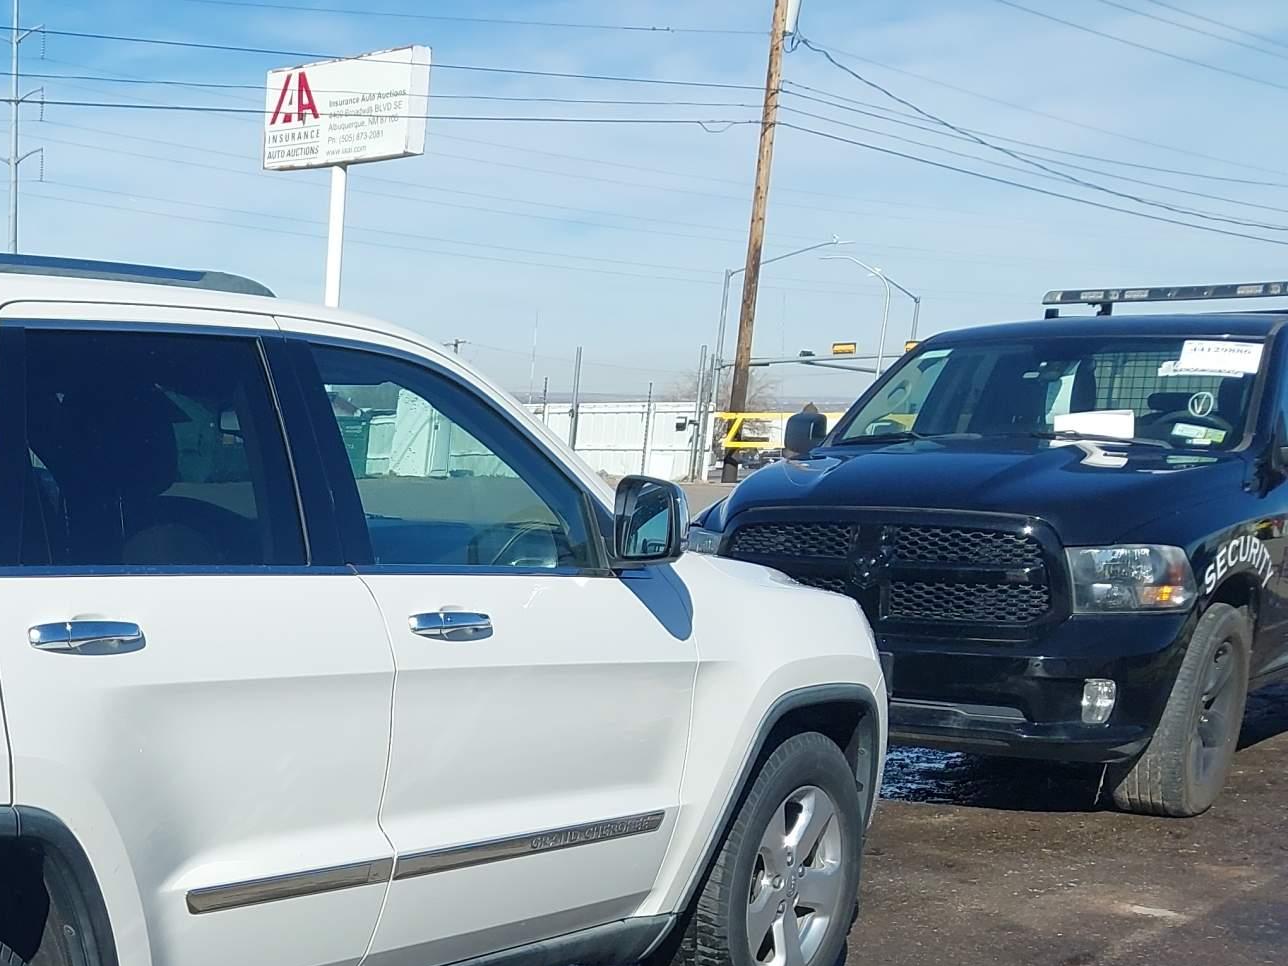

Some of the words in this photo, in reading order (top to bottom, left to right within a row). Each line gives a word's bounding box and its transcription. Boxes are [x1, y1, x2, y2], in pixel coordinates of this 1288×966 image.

[328, 95, 360, 108] Insurance
[361, 92, 376, 103] Auto
[377, 89, 407, 100] Auctions
[374, 101, 392, 113] BLVD
[393, 99, 403, 110] SE
[268, 128, 320, 145] INSURANCE
[267, 149, 285, 160] AUTO
[286, 144, 319, 158] AUCTIONS
[1205, 535, 1274, 594] SECURITY
[530, 831, 582, 849] GRAND
[584, 815, 650, 840] CHEROKEE
